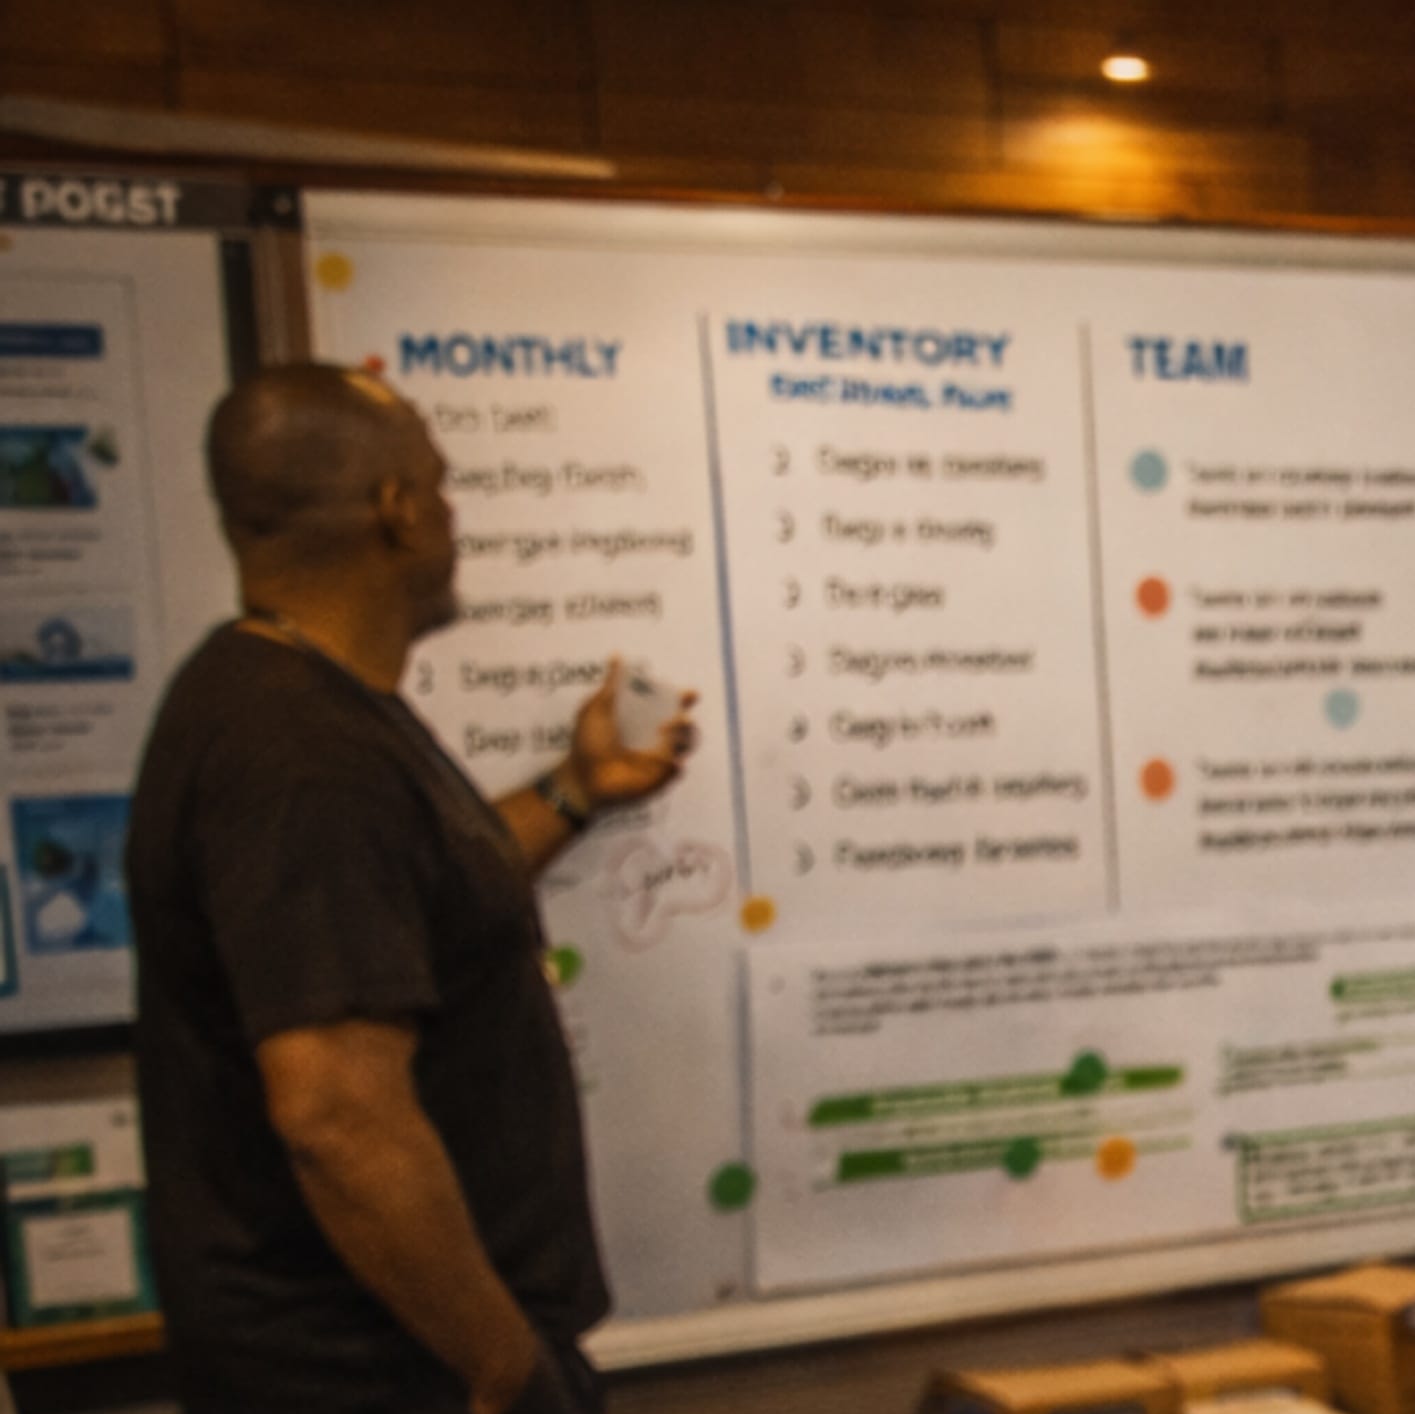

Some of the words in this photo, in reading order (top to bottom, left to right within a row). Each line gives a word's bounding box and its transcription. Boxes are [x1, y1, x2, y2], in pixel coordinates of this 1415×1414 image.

[398, 331, 623, 379] MONTHLY
[726, 320, 1012, 368] INVENTORY
[1126, 336, 1250, 384] TEAM
